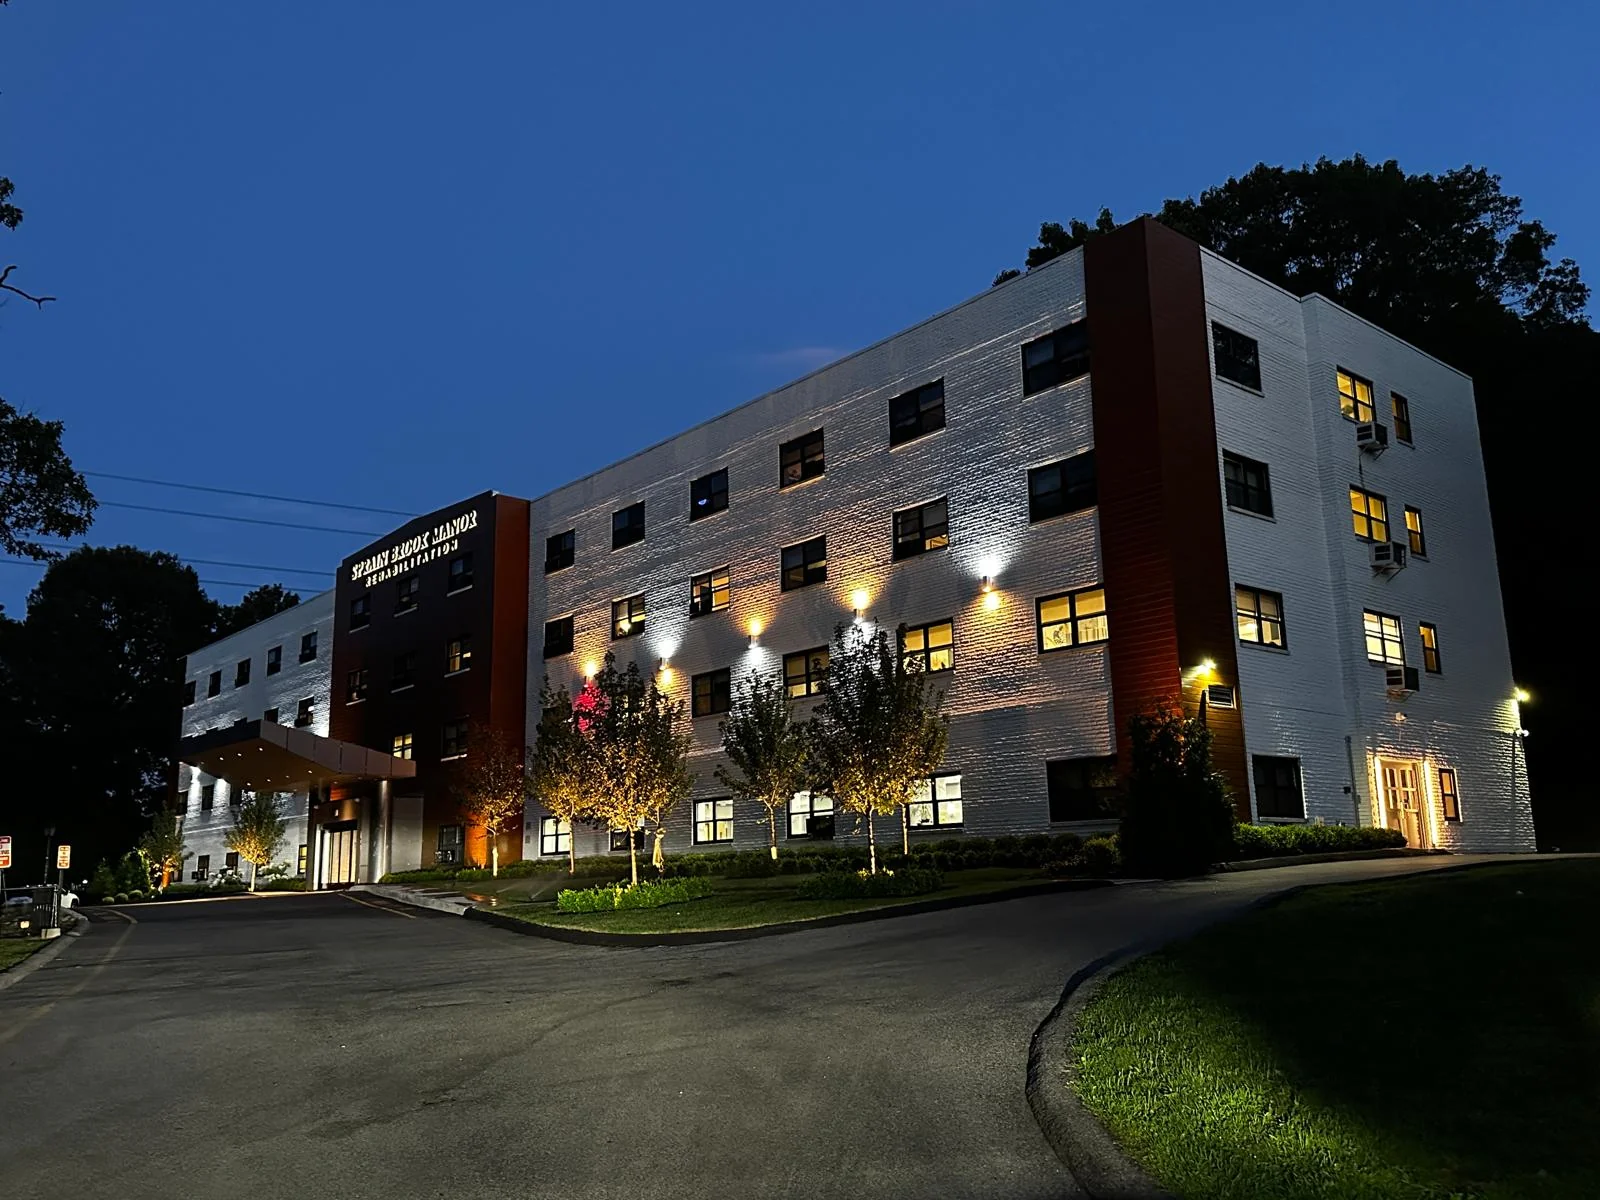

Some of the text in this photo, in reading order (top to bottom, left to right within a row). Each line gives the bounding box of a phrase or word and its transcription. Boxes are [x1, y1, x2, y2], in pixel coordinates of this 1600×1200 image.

[351, 509, 478, 581] SPRAIN BROOK MANOR
[365, 539, 458, 588] REHABILITATION
